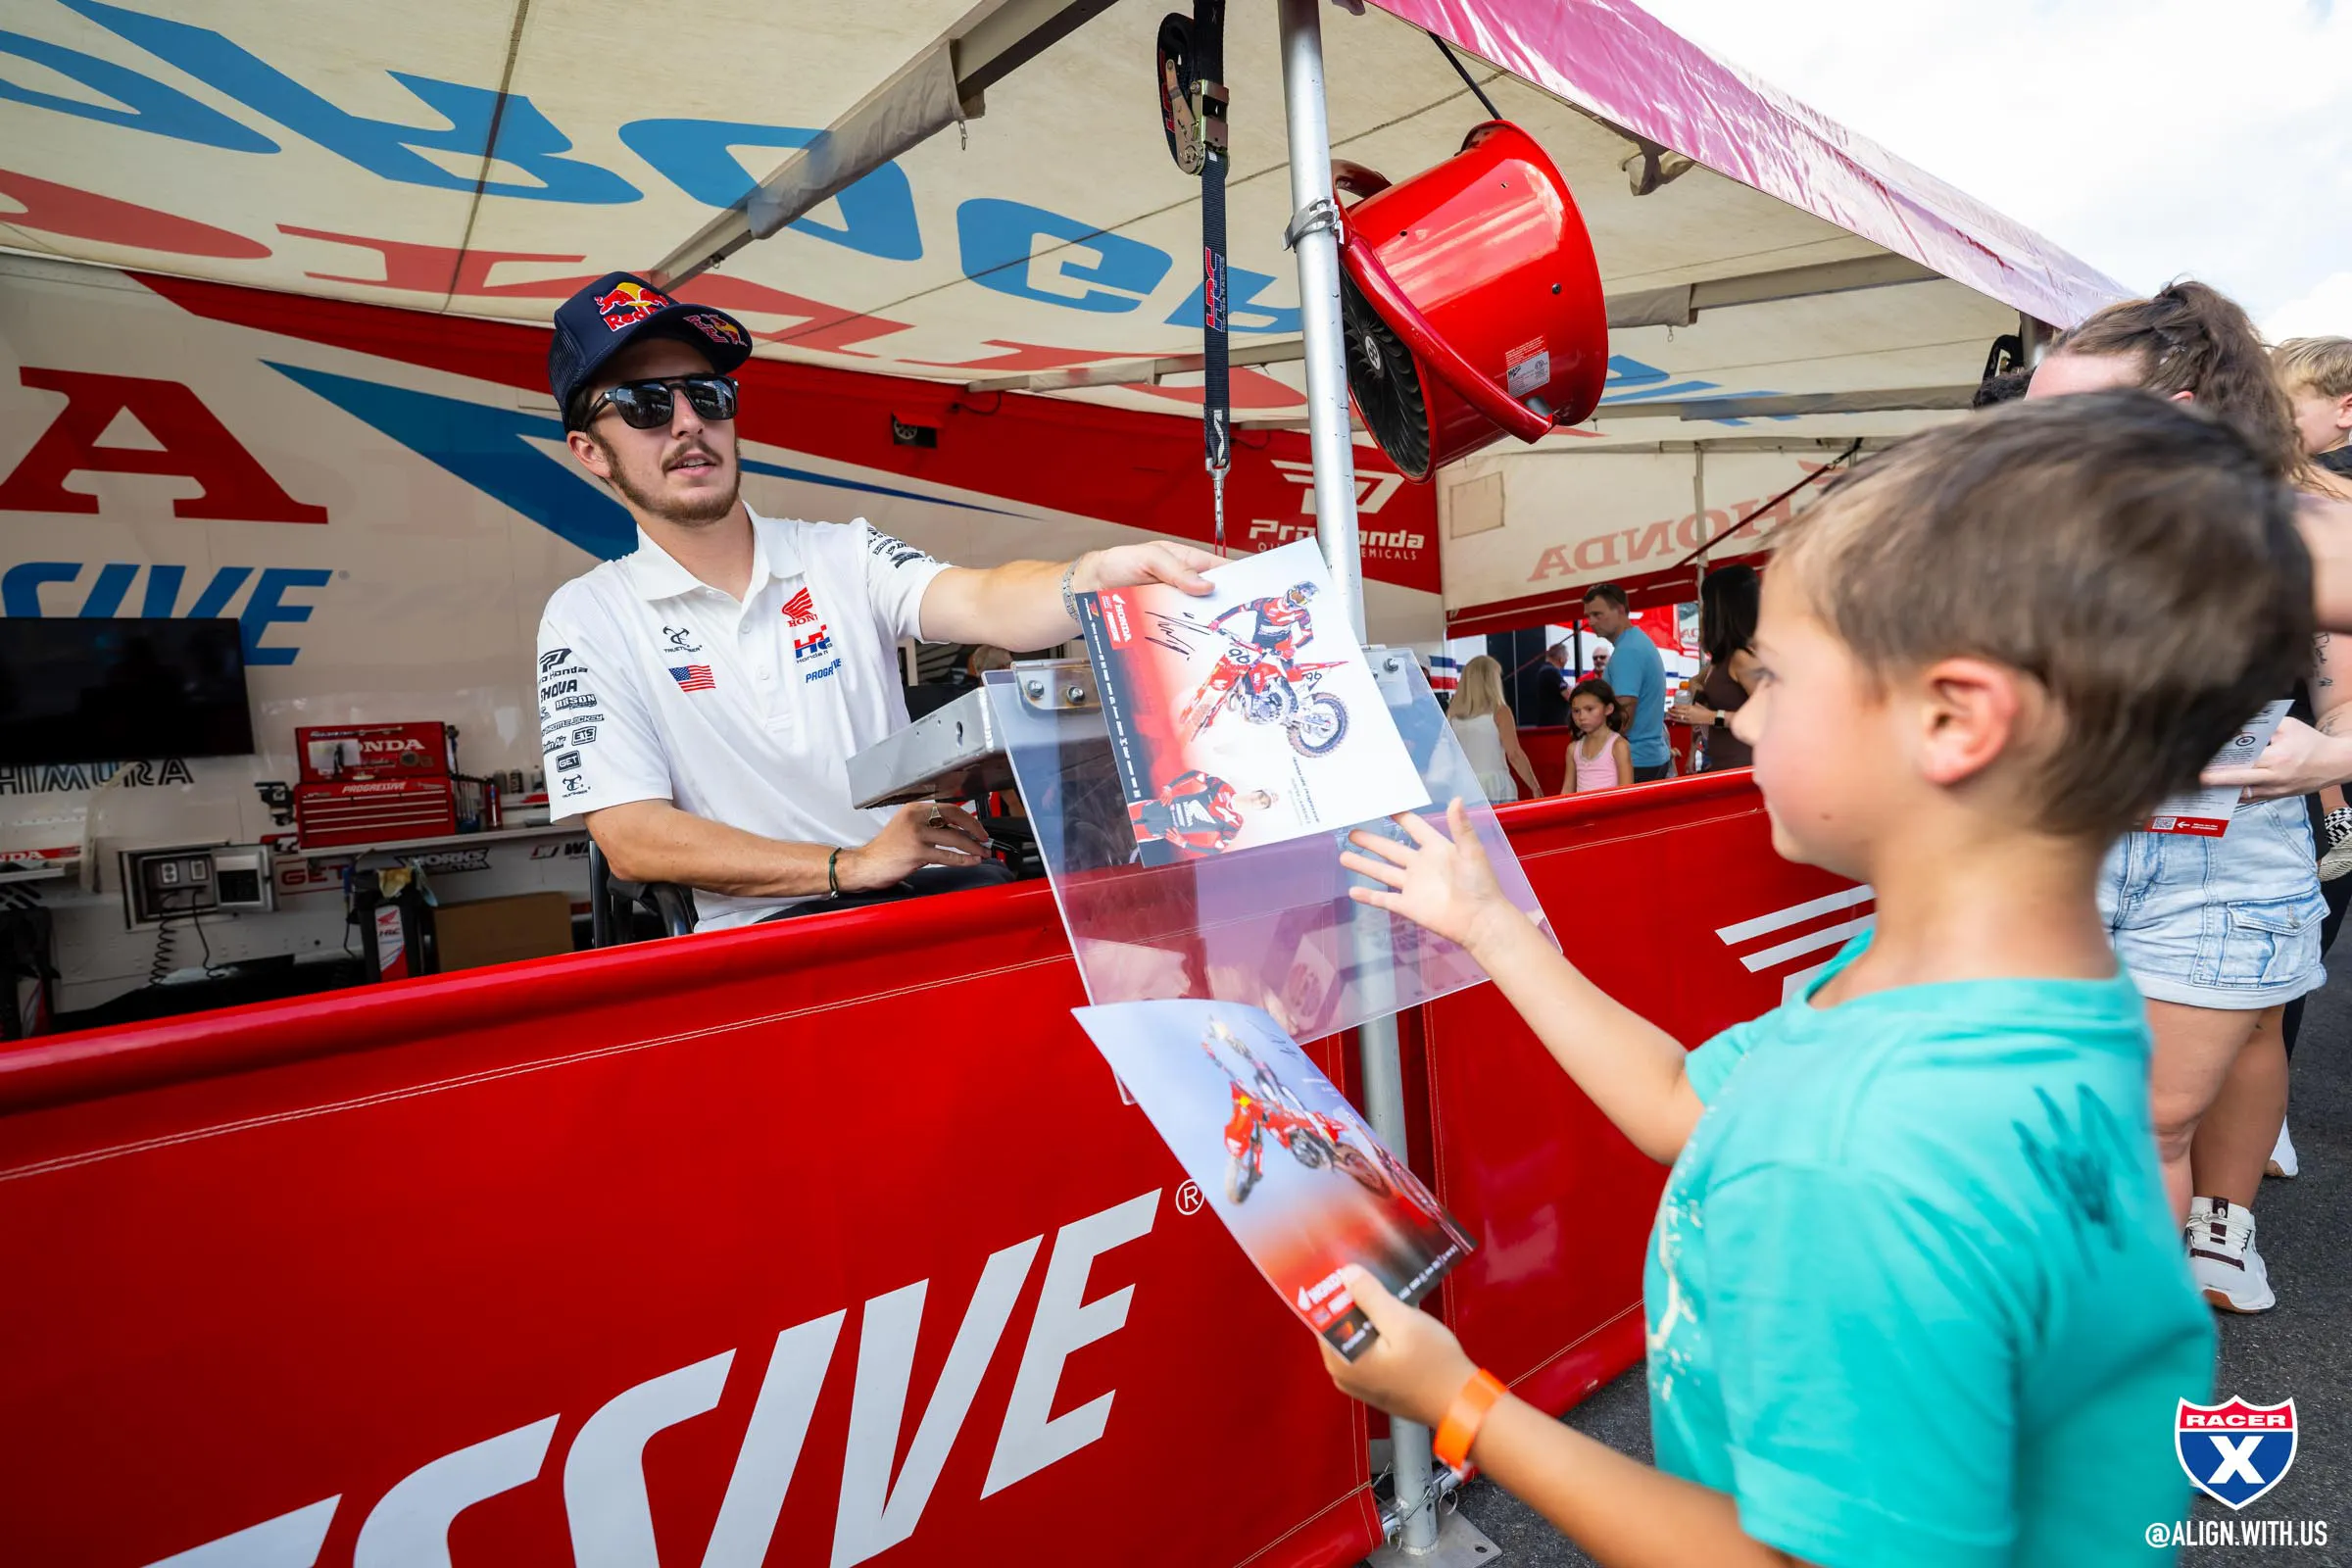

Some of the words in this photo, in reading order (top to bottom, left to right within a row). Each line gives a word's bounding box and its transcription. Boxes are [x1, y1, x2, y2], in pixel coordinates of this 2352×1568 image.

[604, 306, 648, 332] Red
[1359, 530, 1425, 549] nda
[1362, 549, 1417, 561] EMICALS
[787, 613, 818, 627] HON
[1228, 648, 1250, 664] 96
[1305, 671, 1323, 682] 96
[574, 728, 594, 741] ETS
[360, 739, 416, 752] NDA
